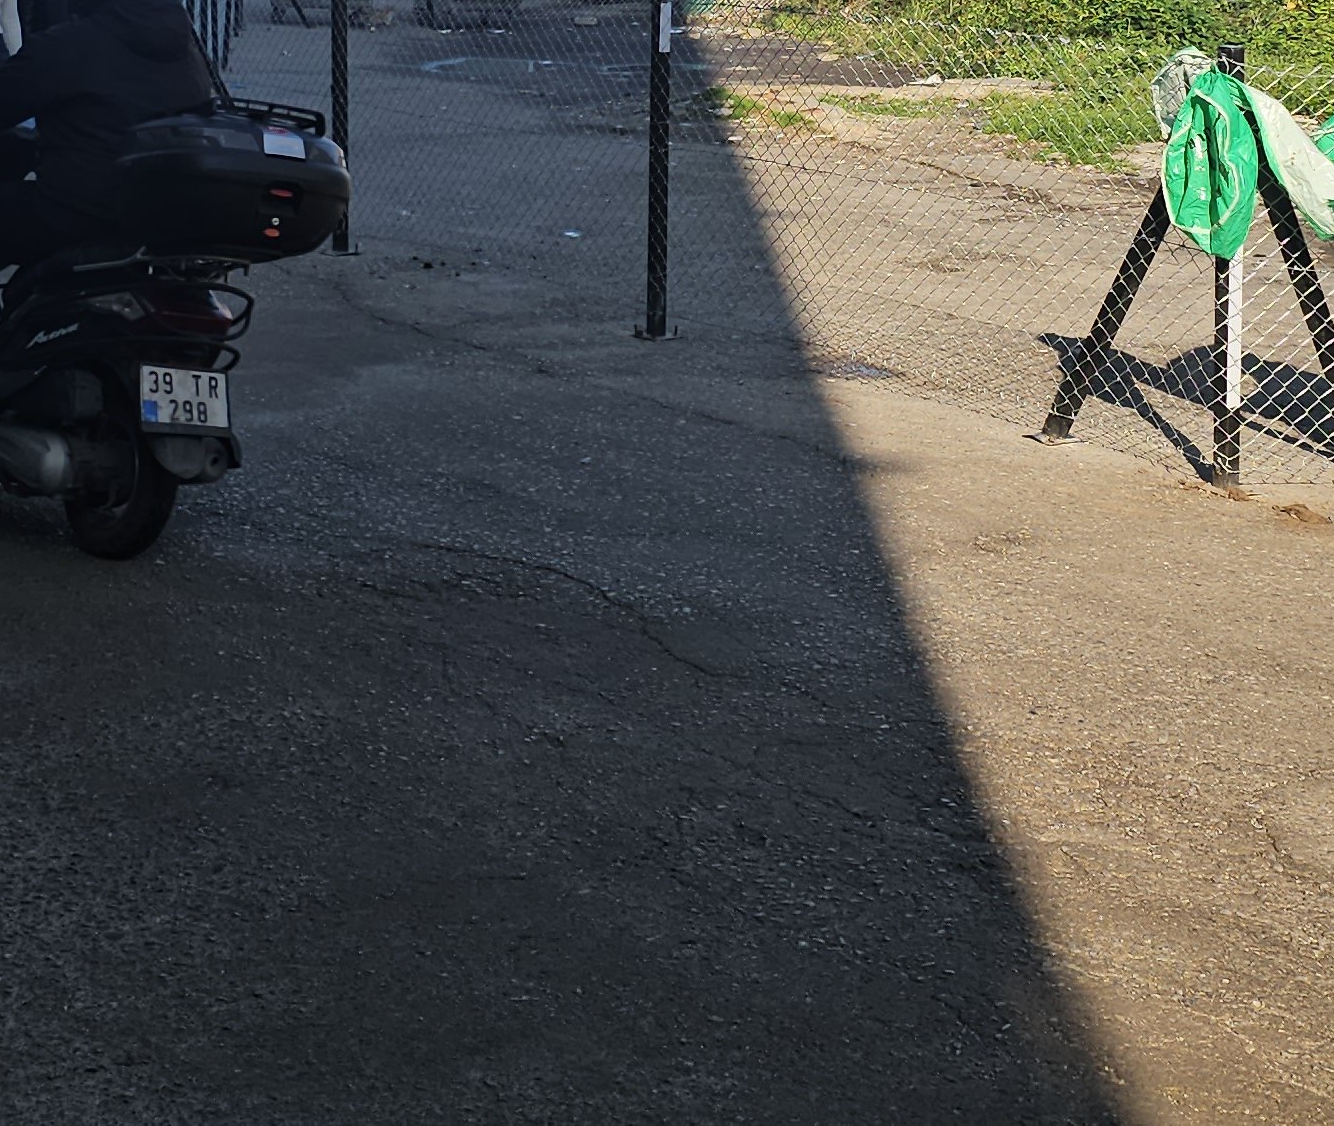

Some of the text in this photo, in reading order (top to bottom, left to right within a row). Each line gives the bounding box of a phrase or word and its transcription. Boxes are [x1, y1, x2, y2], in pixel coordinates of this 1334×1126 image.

[149, 371, 219, 399] 39 TR
[169, 399, 208, 423] 298
